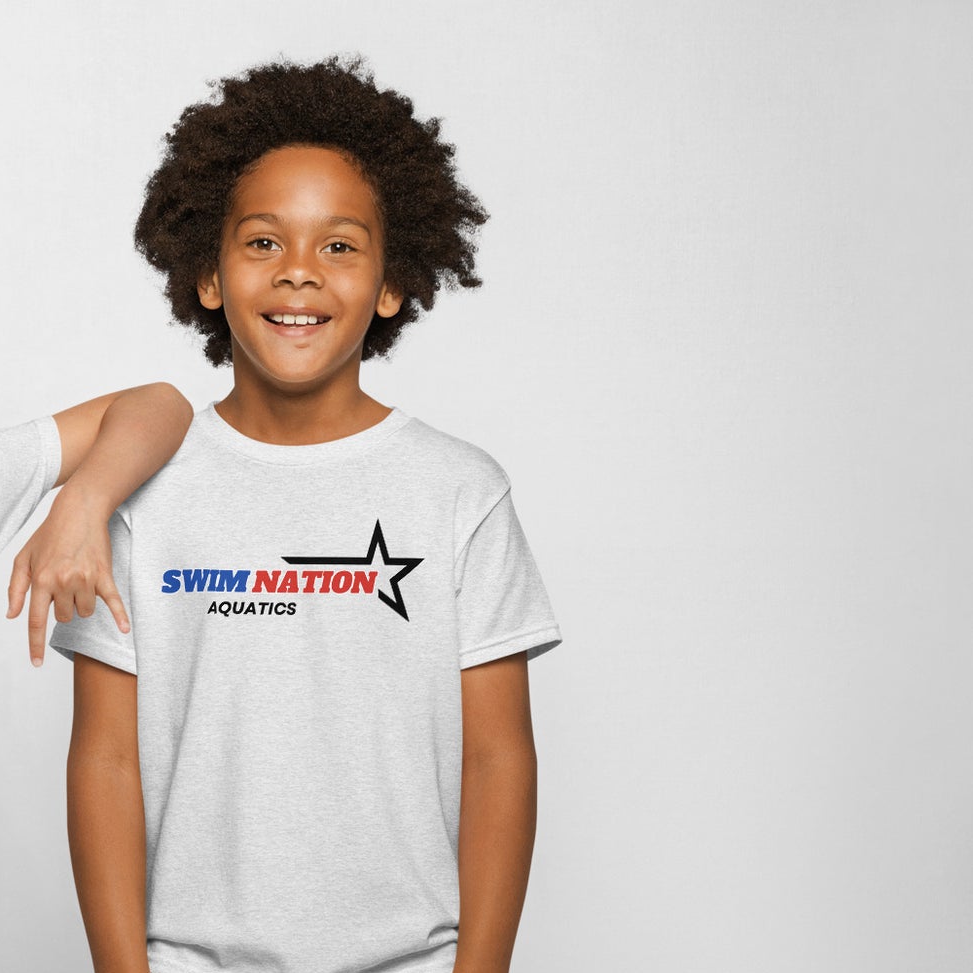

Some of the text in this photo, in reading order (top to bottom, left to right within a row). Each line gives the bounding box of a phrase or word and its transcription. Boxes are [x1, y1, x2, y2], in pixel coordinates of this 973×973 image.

[161, 569, 379, 594] SWIM NATION
[207, 600, 297, 617] AQUATICS
